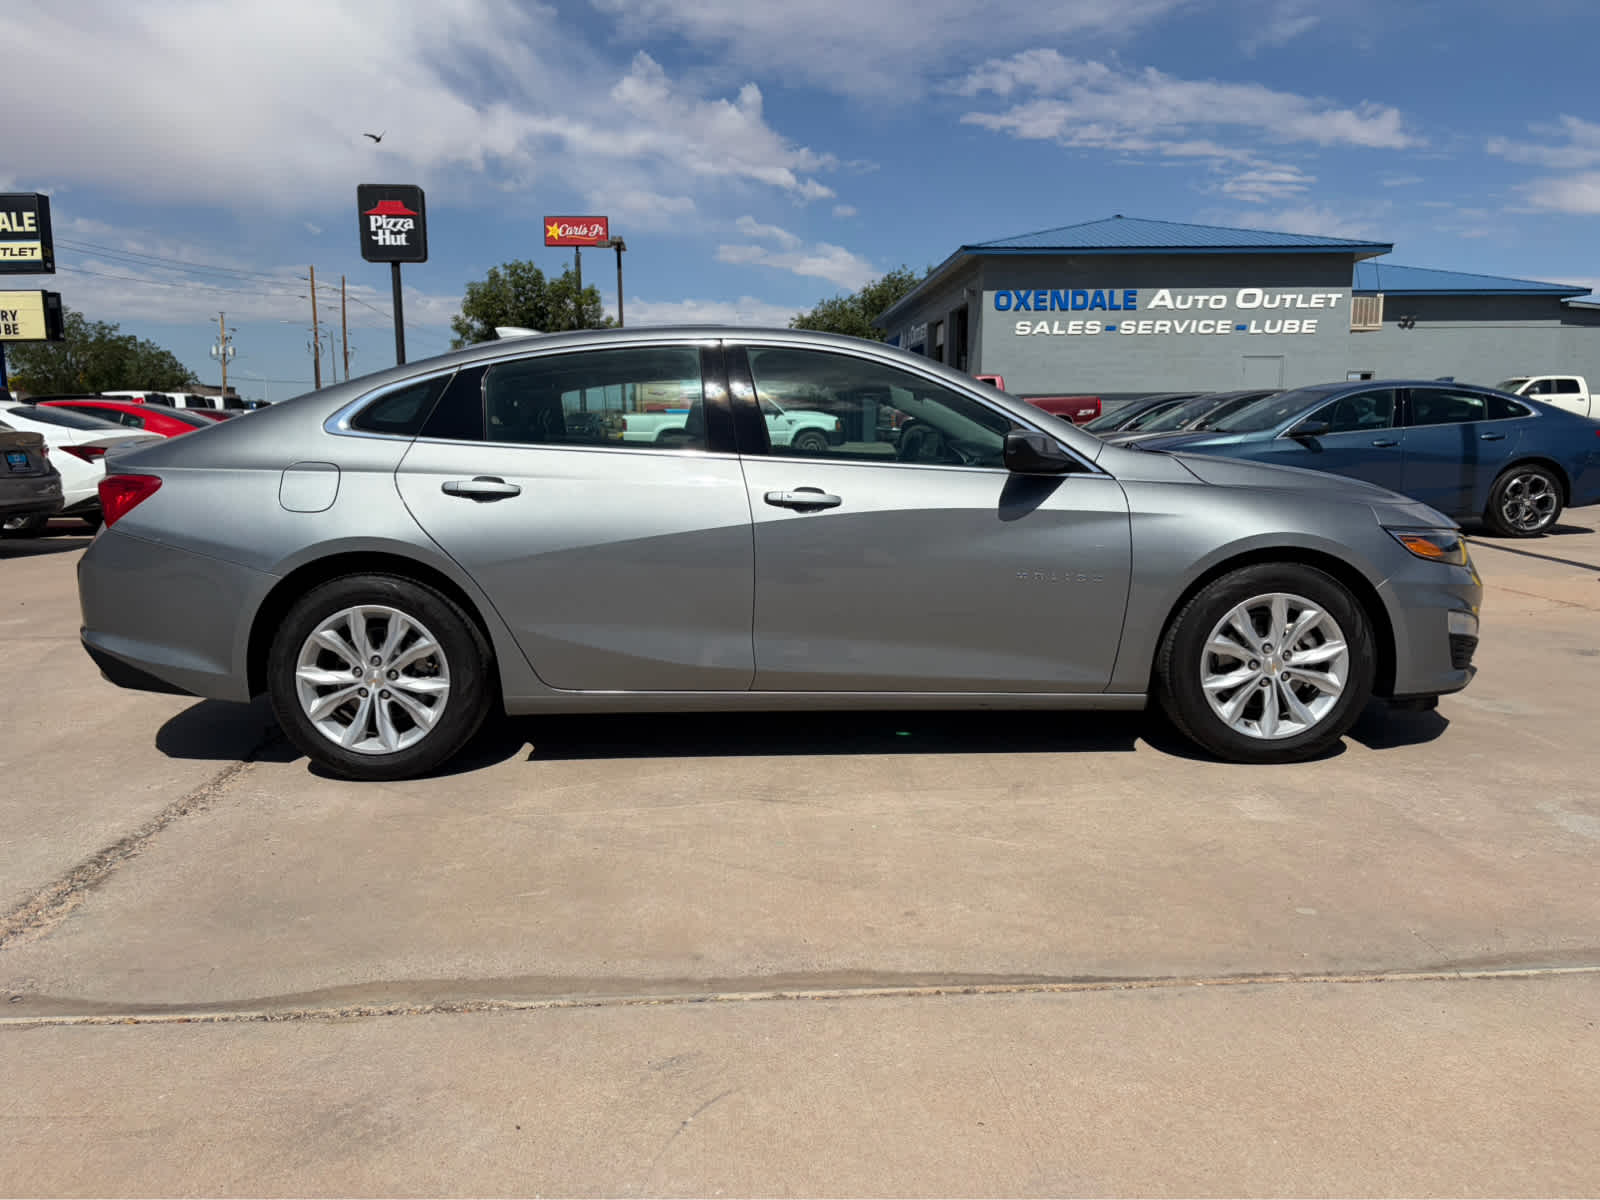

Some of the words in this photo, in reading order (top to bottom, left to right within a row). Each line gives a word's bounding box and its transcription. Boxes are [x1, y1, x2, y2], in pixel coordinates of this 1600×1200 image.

[369, 215, 415, 232] Pizza
[559, 223, 588, 237] Carl's
[371, 229, 411, 246] Hut
[994, 289, 1138, 312] OXENDALE
[1147, 289, 1228, 310] AUTO
[1235, 288, 1343, 309] OUTLET
[0, 323, 19, 335] BE
